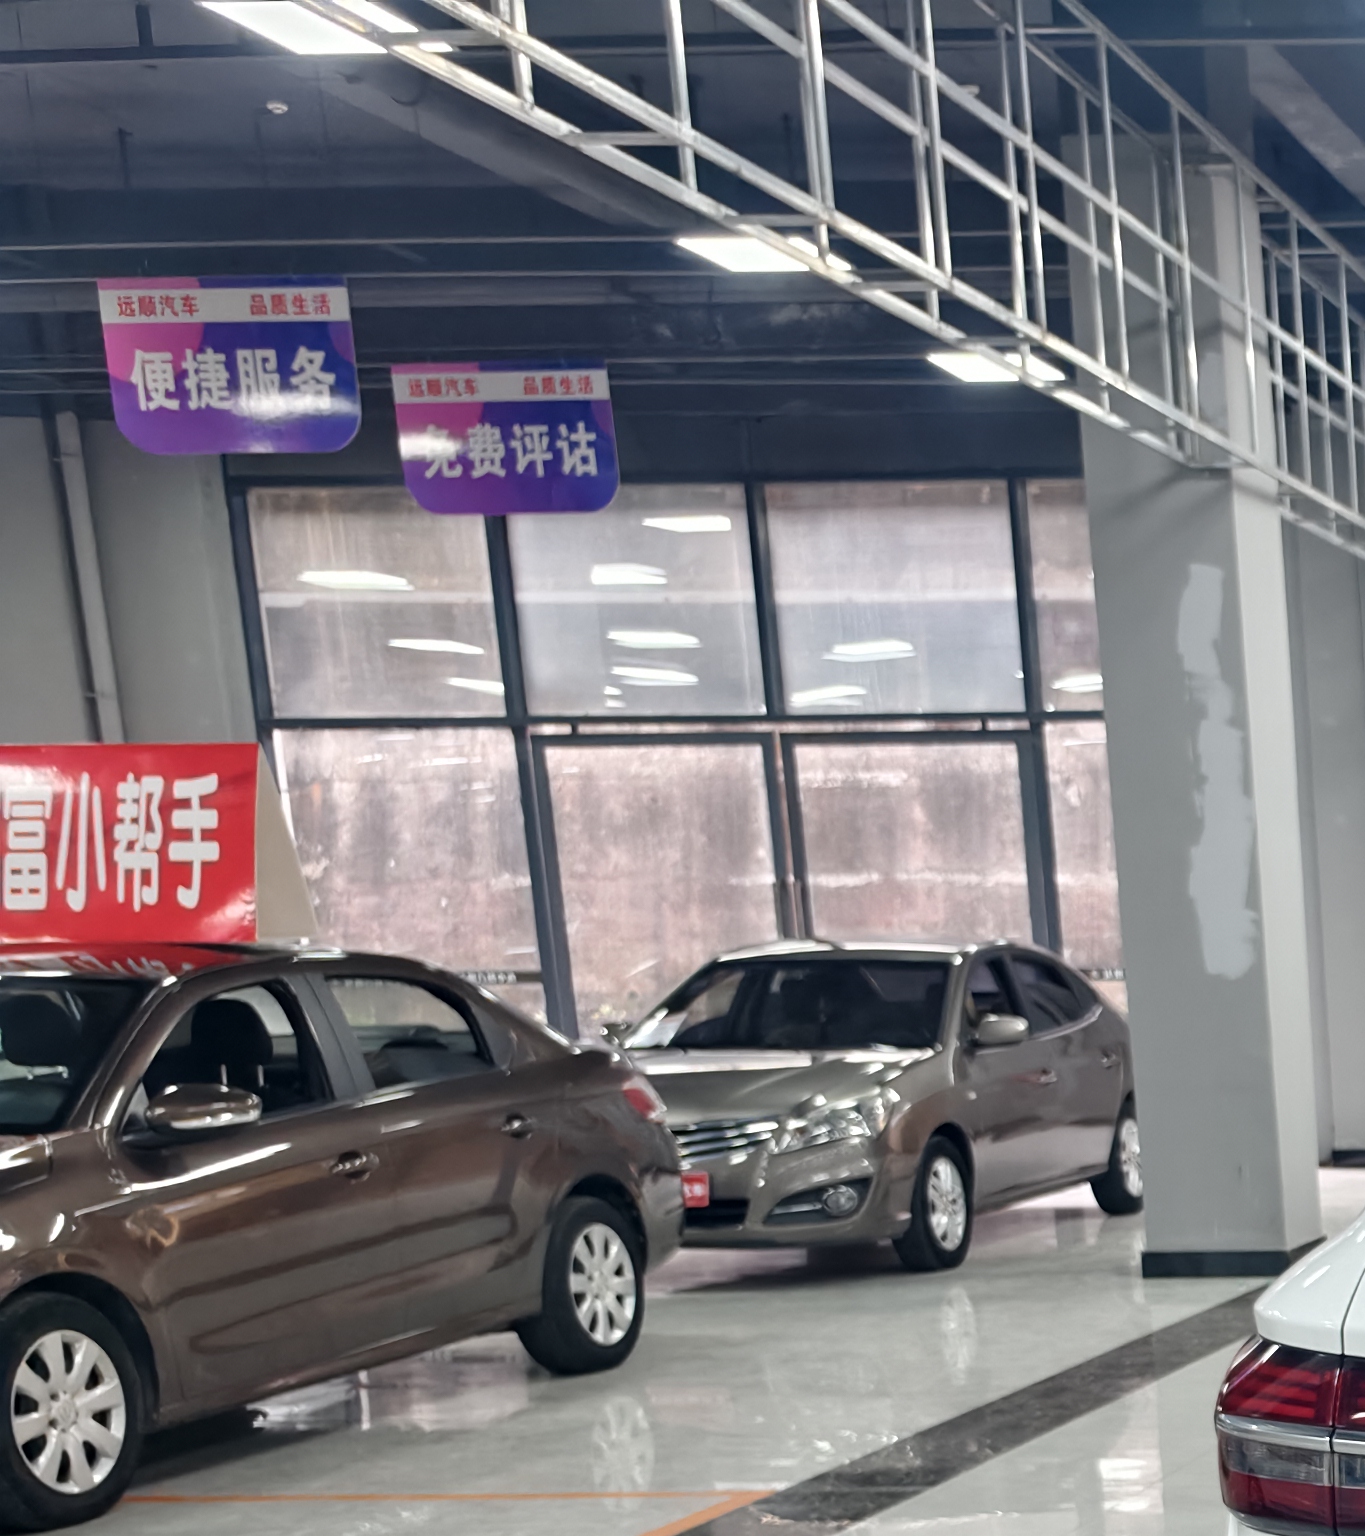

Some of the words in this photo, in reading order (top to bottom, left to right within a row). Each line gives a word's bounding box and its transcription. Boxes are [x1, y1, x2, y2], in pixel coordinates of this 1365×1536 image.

[117, 294, 200, 317] 远顺汽车
[250, 293, 331, 316] 品质生活
[130, 345, 336, 412] 便捷服务
